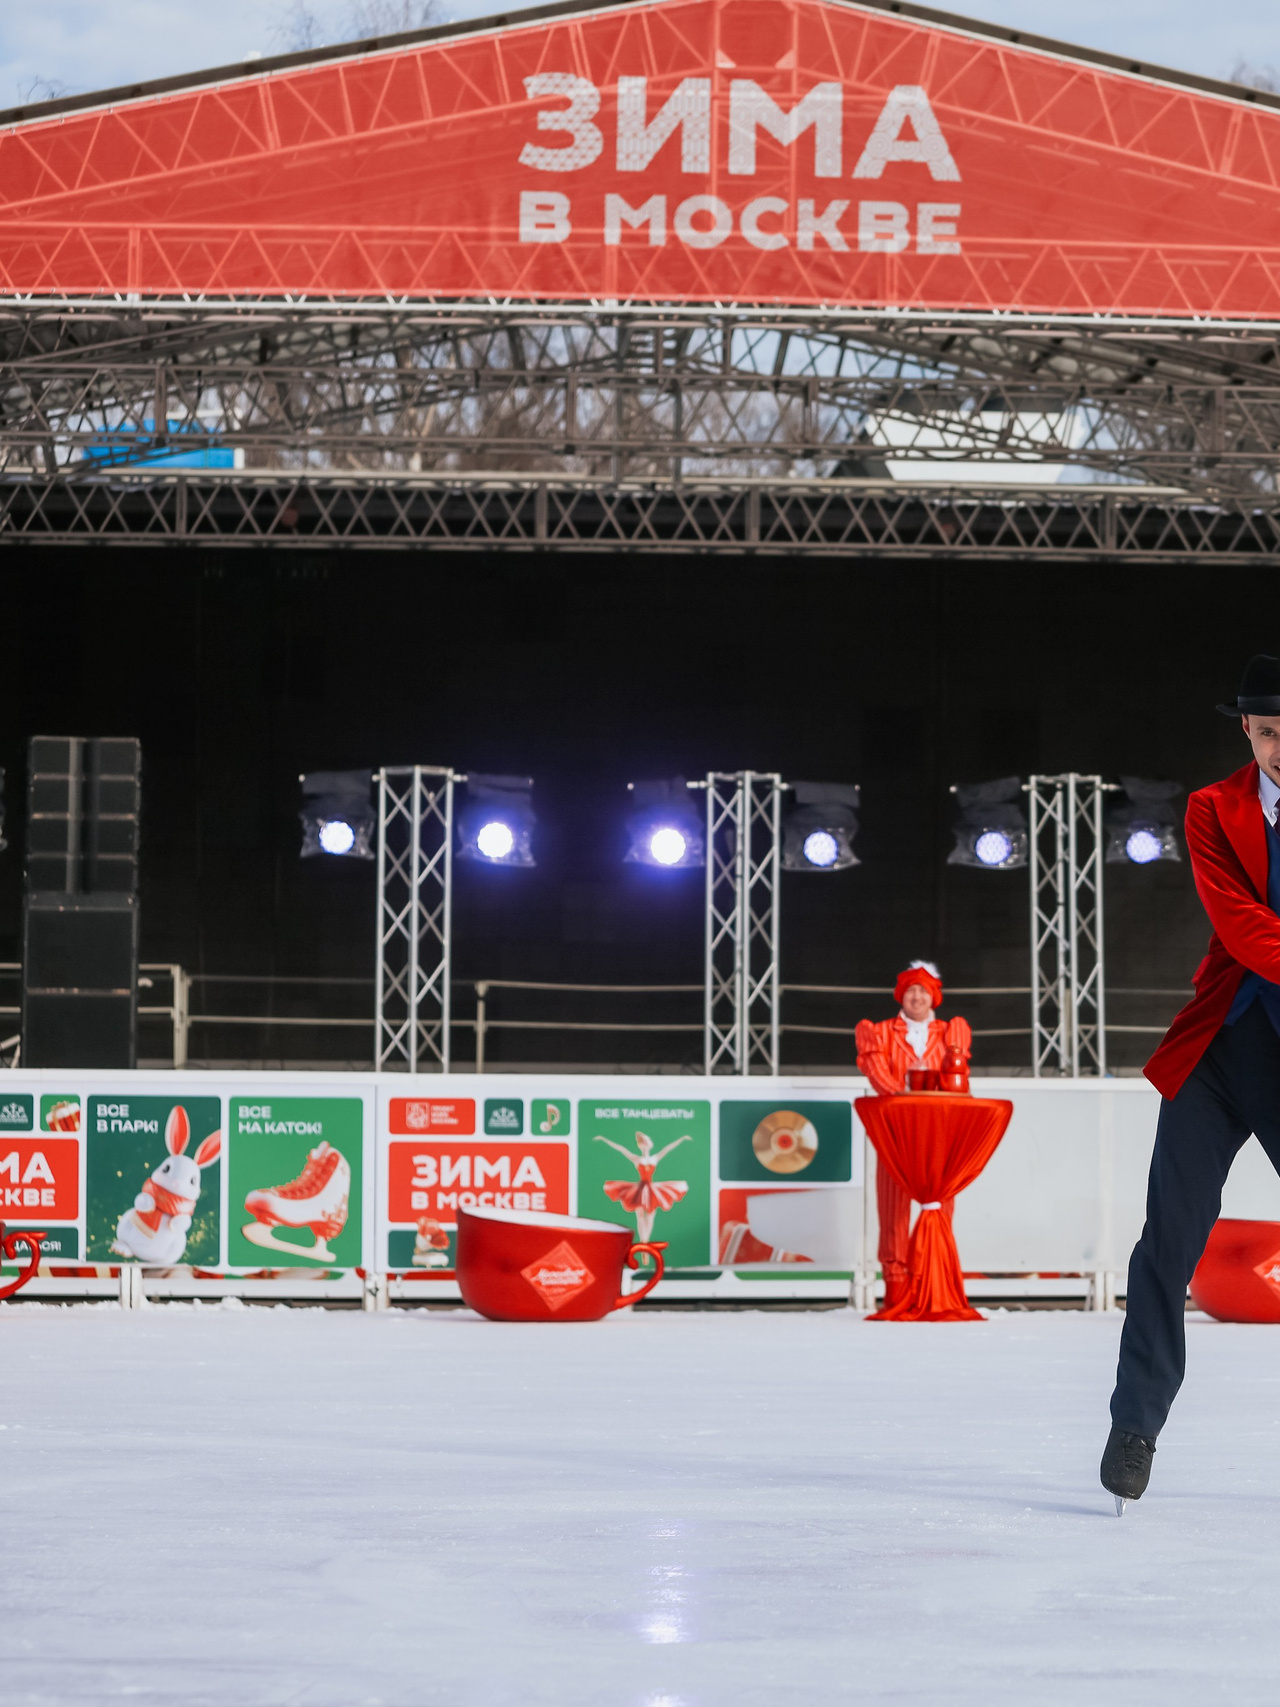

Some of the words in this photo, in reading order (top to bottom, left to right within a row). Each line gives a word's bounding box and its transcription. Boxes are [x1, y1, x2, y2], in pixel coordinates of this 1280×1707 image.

[518, 72, 962, 181] ЗИМА
[519, 191, 571, 242] В
[604, 193, 962, 254] МОСКВЕ
[97, 1104, 129, 1118] ВСЕ
[238, 1105, 271, 1119] ВСЕ
[594, 1108, 619, 1119] ВСЕ
[97, 1119, 108, 1133] В
[111, 1119, 159, 1134] ПАРК!
[238, 1121, 262, 1134] НА
[264, 1121, 322, 1135] КАТОК!
[411, 1154, 546, 1188] ЗИМА
[0, 1187, 56, 1207] КВЕ
[411, 1191, 429, 1210] В
[436, 1191, 547, 1210] МОСКВЕ
